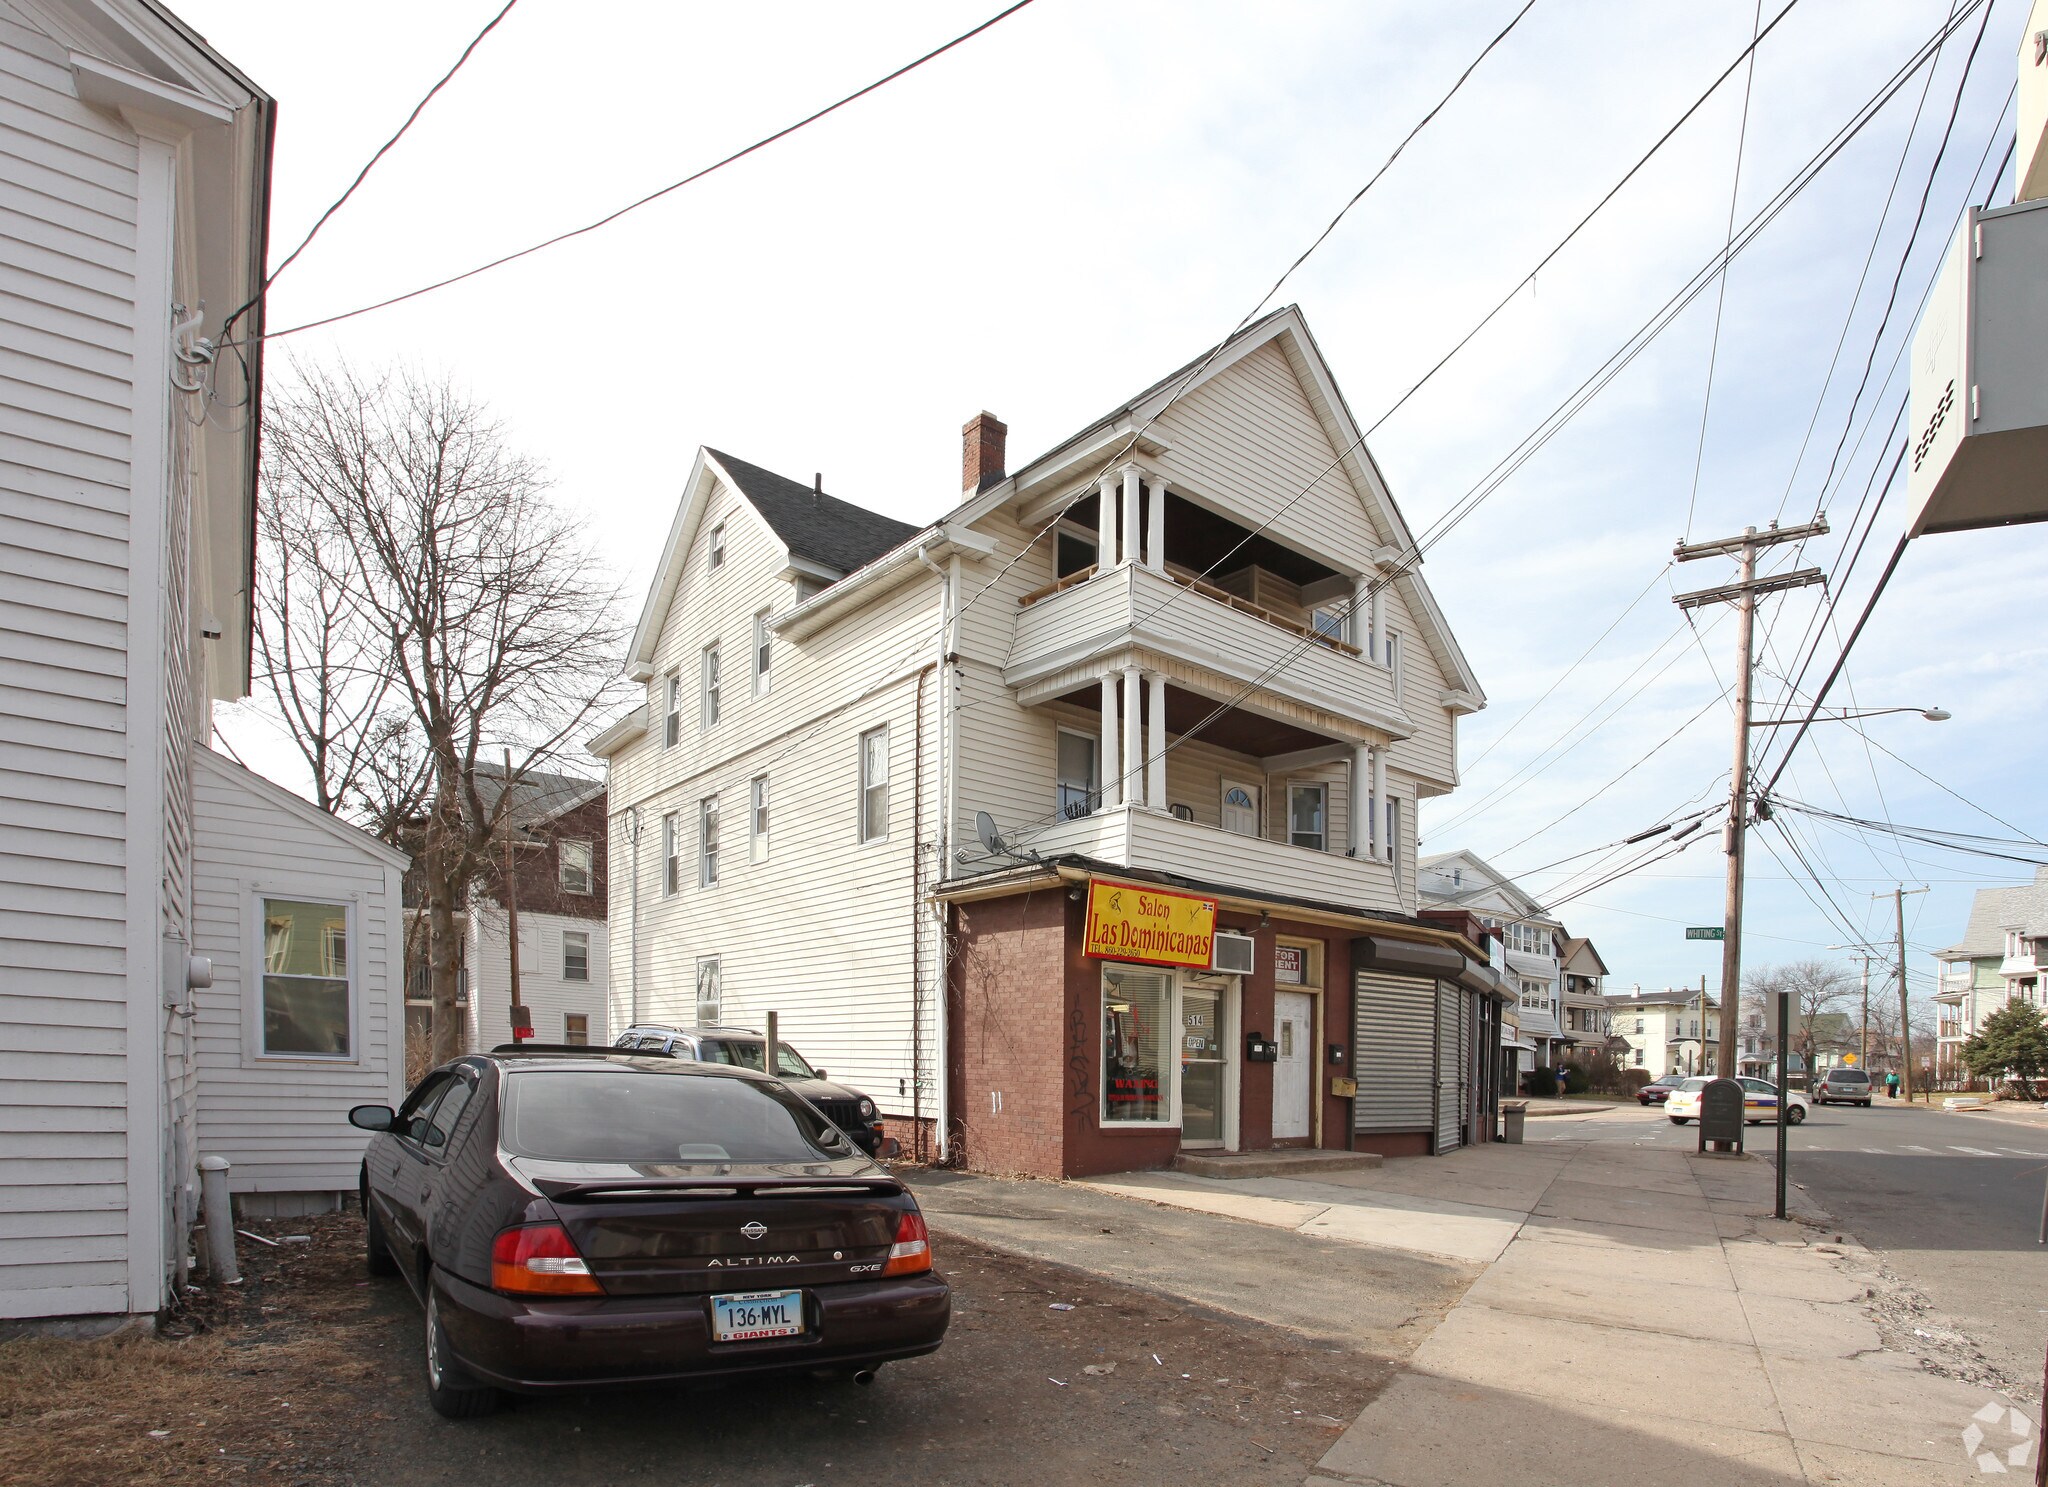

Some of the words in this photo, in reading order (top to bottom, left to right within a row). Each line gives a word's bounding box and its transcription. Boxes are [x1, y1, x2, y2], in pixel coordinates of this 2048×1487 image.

[1138, 895, 1171, 920] Salon
[1092, 913, 1118, 945] Las
[1120, 920, 1209, 958] Dominicanas
[1687, 929, 1715, 938] WHITING
[1275, 950, 1295, 960] FOR
[1188, 1015, 1203, 1025] 514
[1188, 1037, 1204, 1048] OPEN
[708, 1255, 800, 1267] ALTIMA
[850, 1264, 882, 1272] GXE
[733, 1328, 788, 1339] GIANTS
